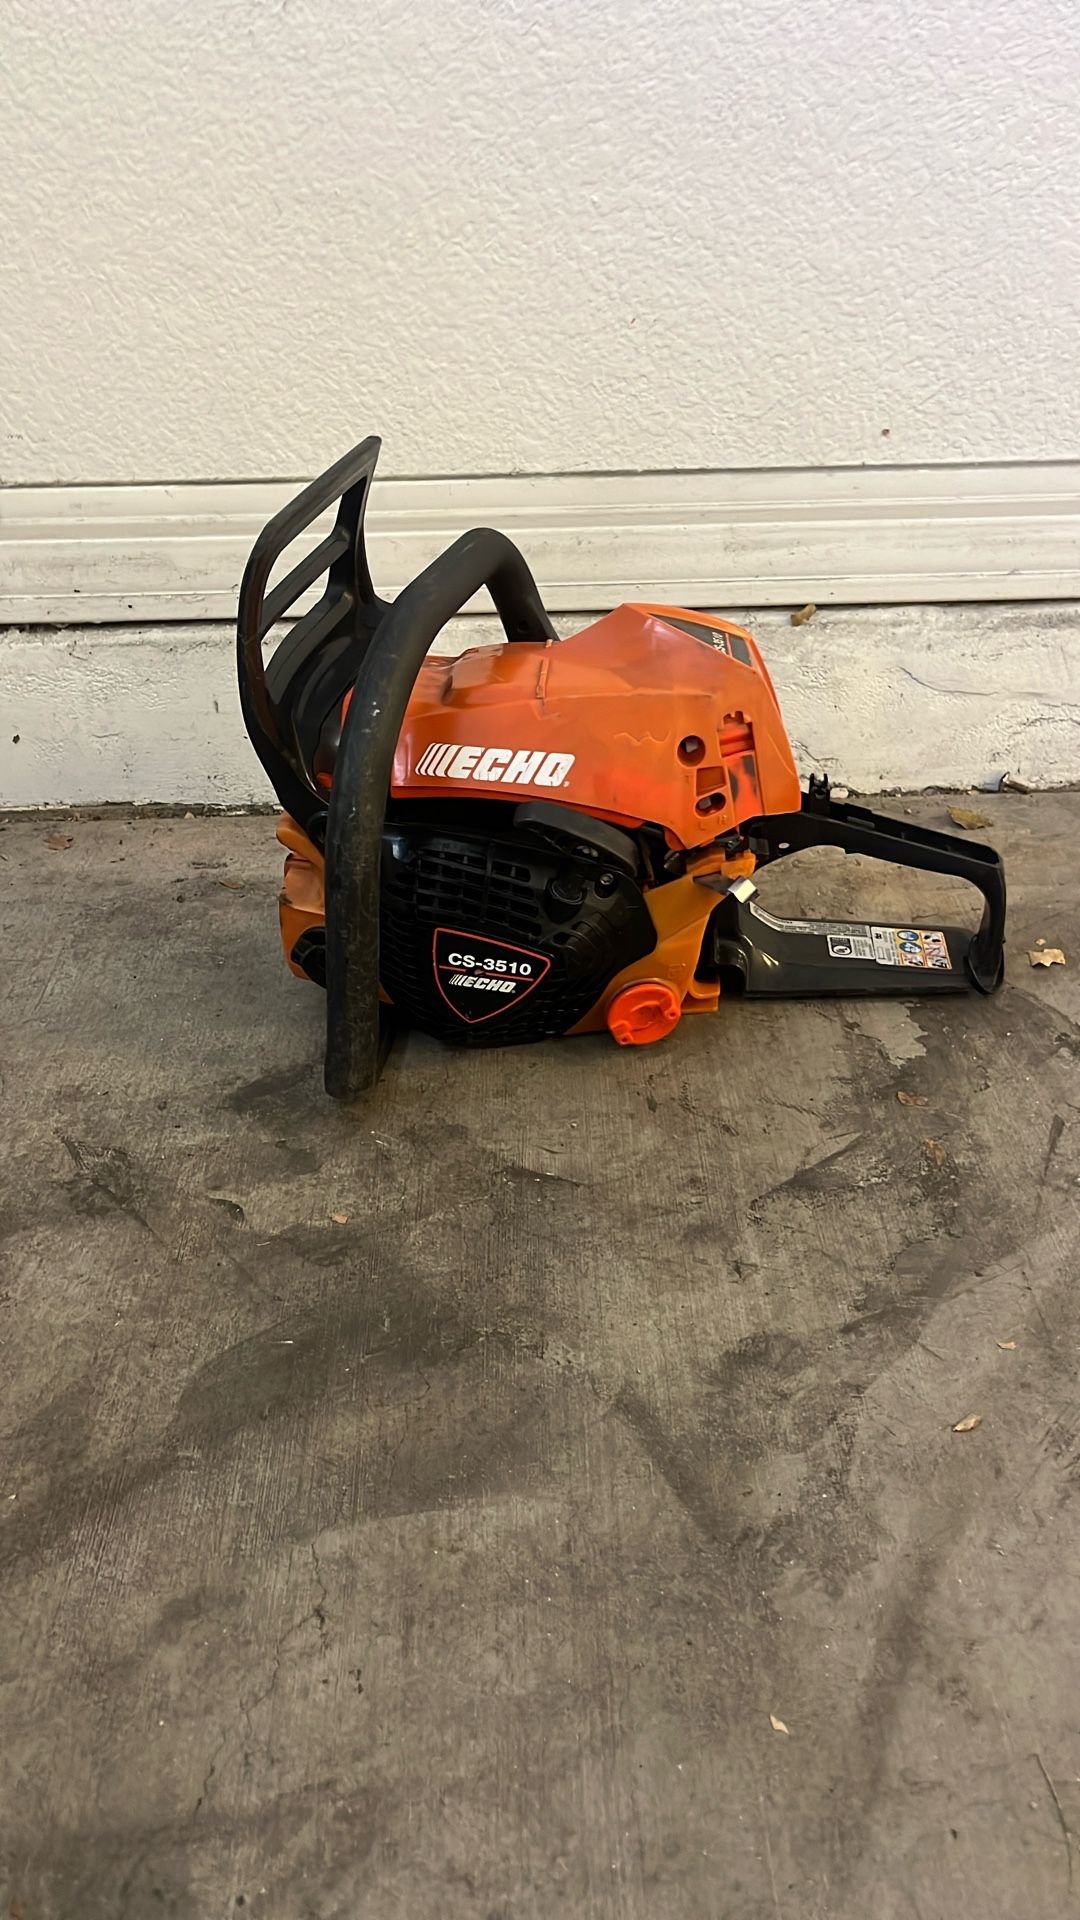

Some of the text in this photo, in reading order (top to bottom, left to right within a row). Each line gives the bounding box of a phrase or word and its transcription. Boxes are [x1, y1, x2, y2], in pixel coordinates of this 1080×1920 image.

[447, 746, 576, 787] ECHO
[448, 953, 532, 976] CS-3510
[462, 976, 517, 993] ECHO
